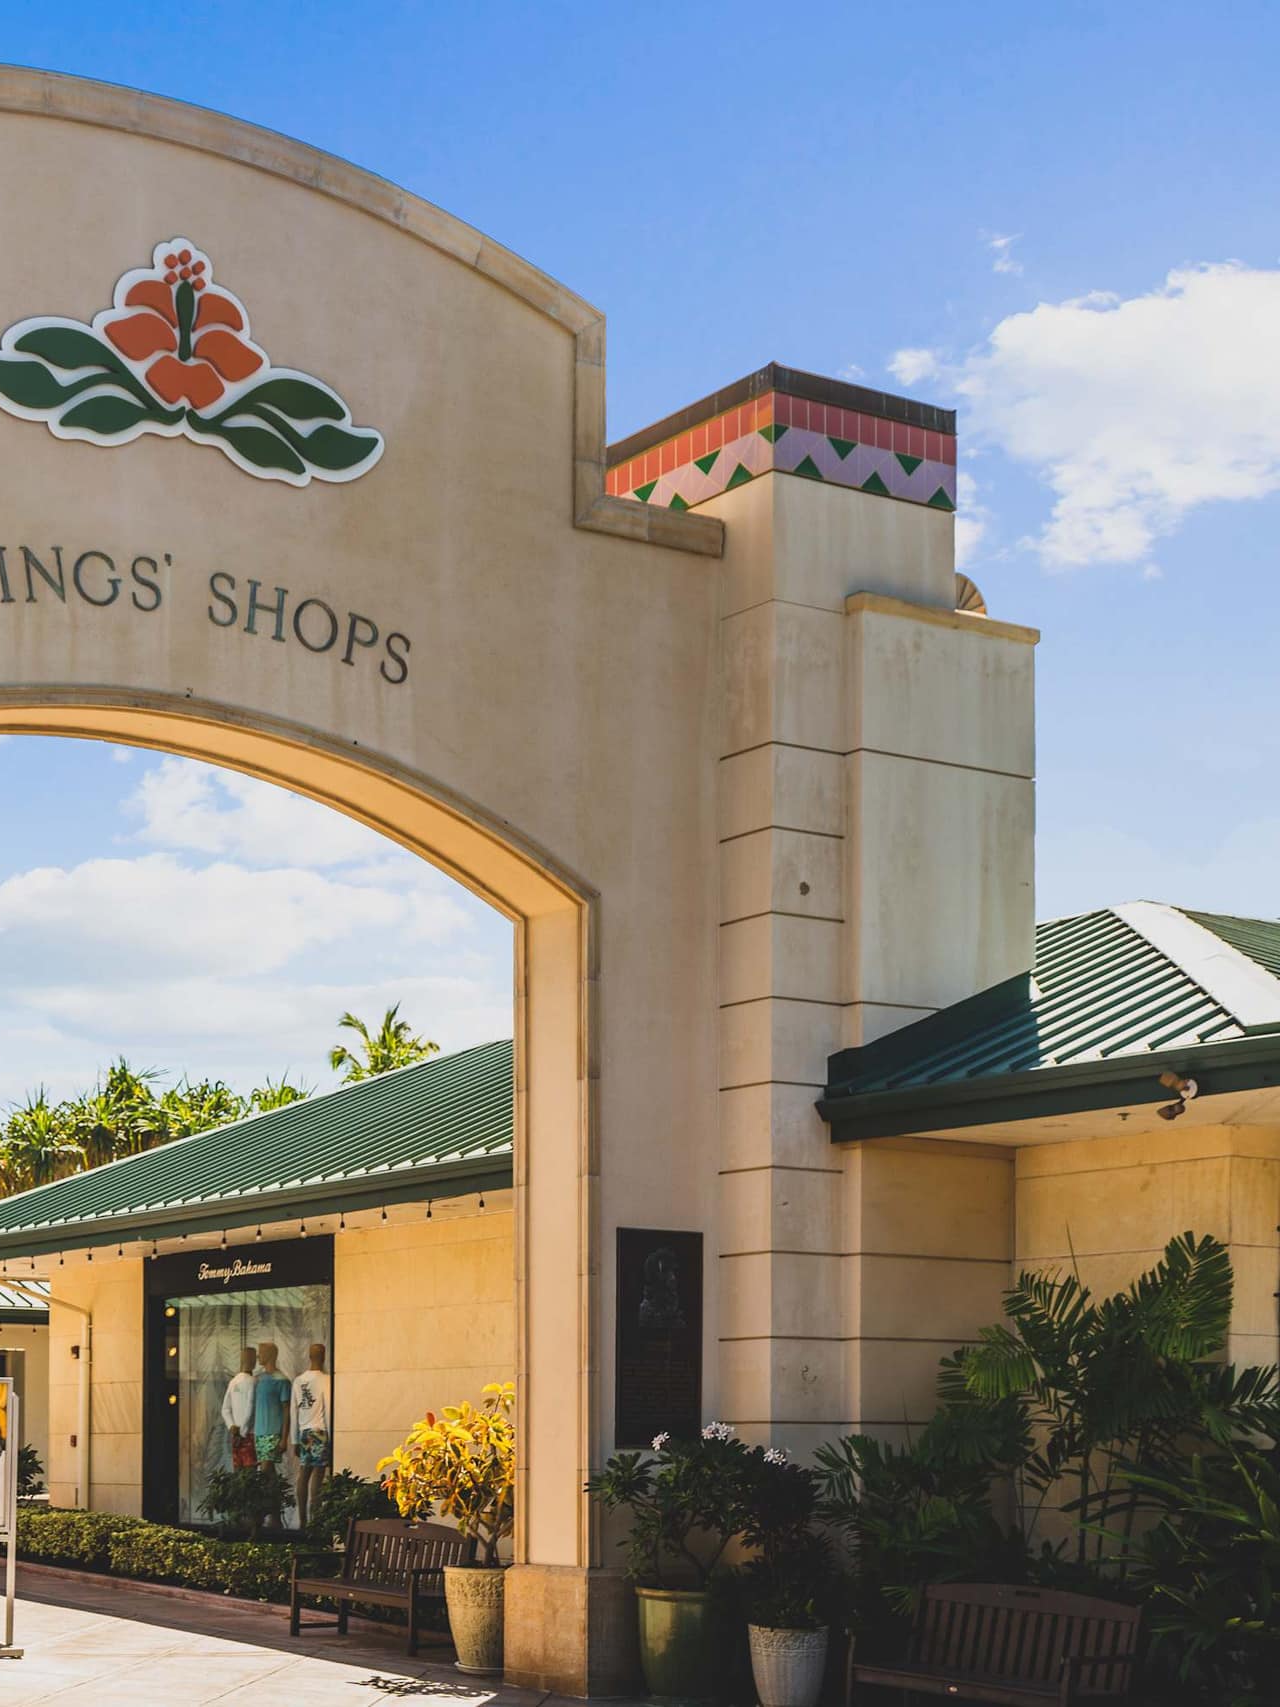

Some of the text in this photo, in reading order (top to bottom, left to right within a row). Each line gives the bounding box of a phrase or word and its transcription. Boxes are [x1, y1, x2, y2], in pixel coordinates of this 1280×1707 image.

[207, 571, 412, 685] SHOPS
[198, 1259, 273, 1284] Tommy Bahama
